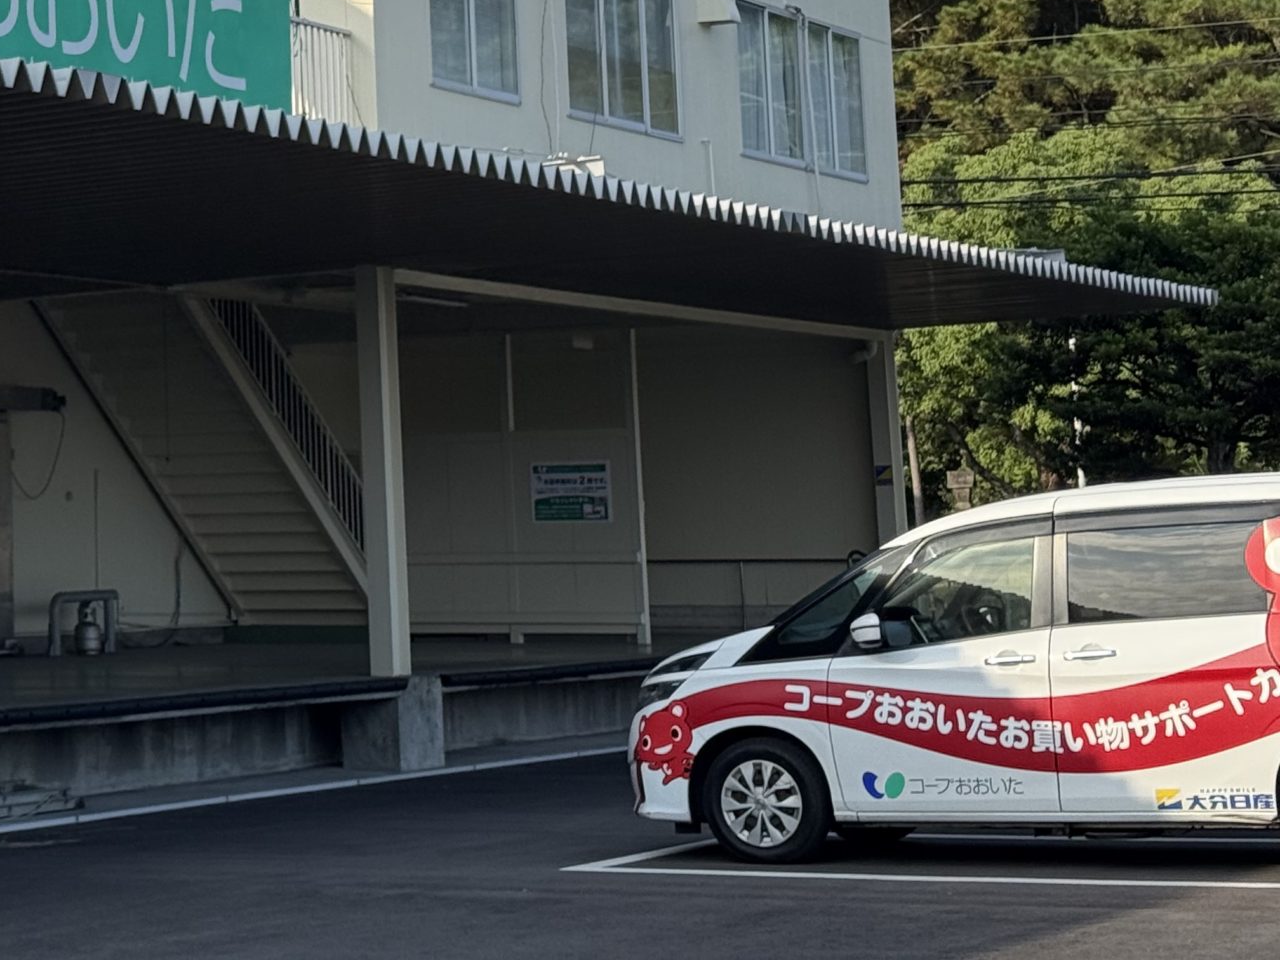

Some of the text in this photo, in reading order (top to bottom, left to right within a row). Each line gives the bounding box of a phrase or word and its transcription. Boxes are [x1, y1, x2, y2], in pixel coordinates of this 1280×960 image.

[908, 776, 1025, 796] コープおおいた
[1186, 794, 1275, 810] 大分日産
